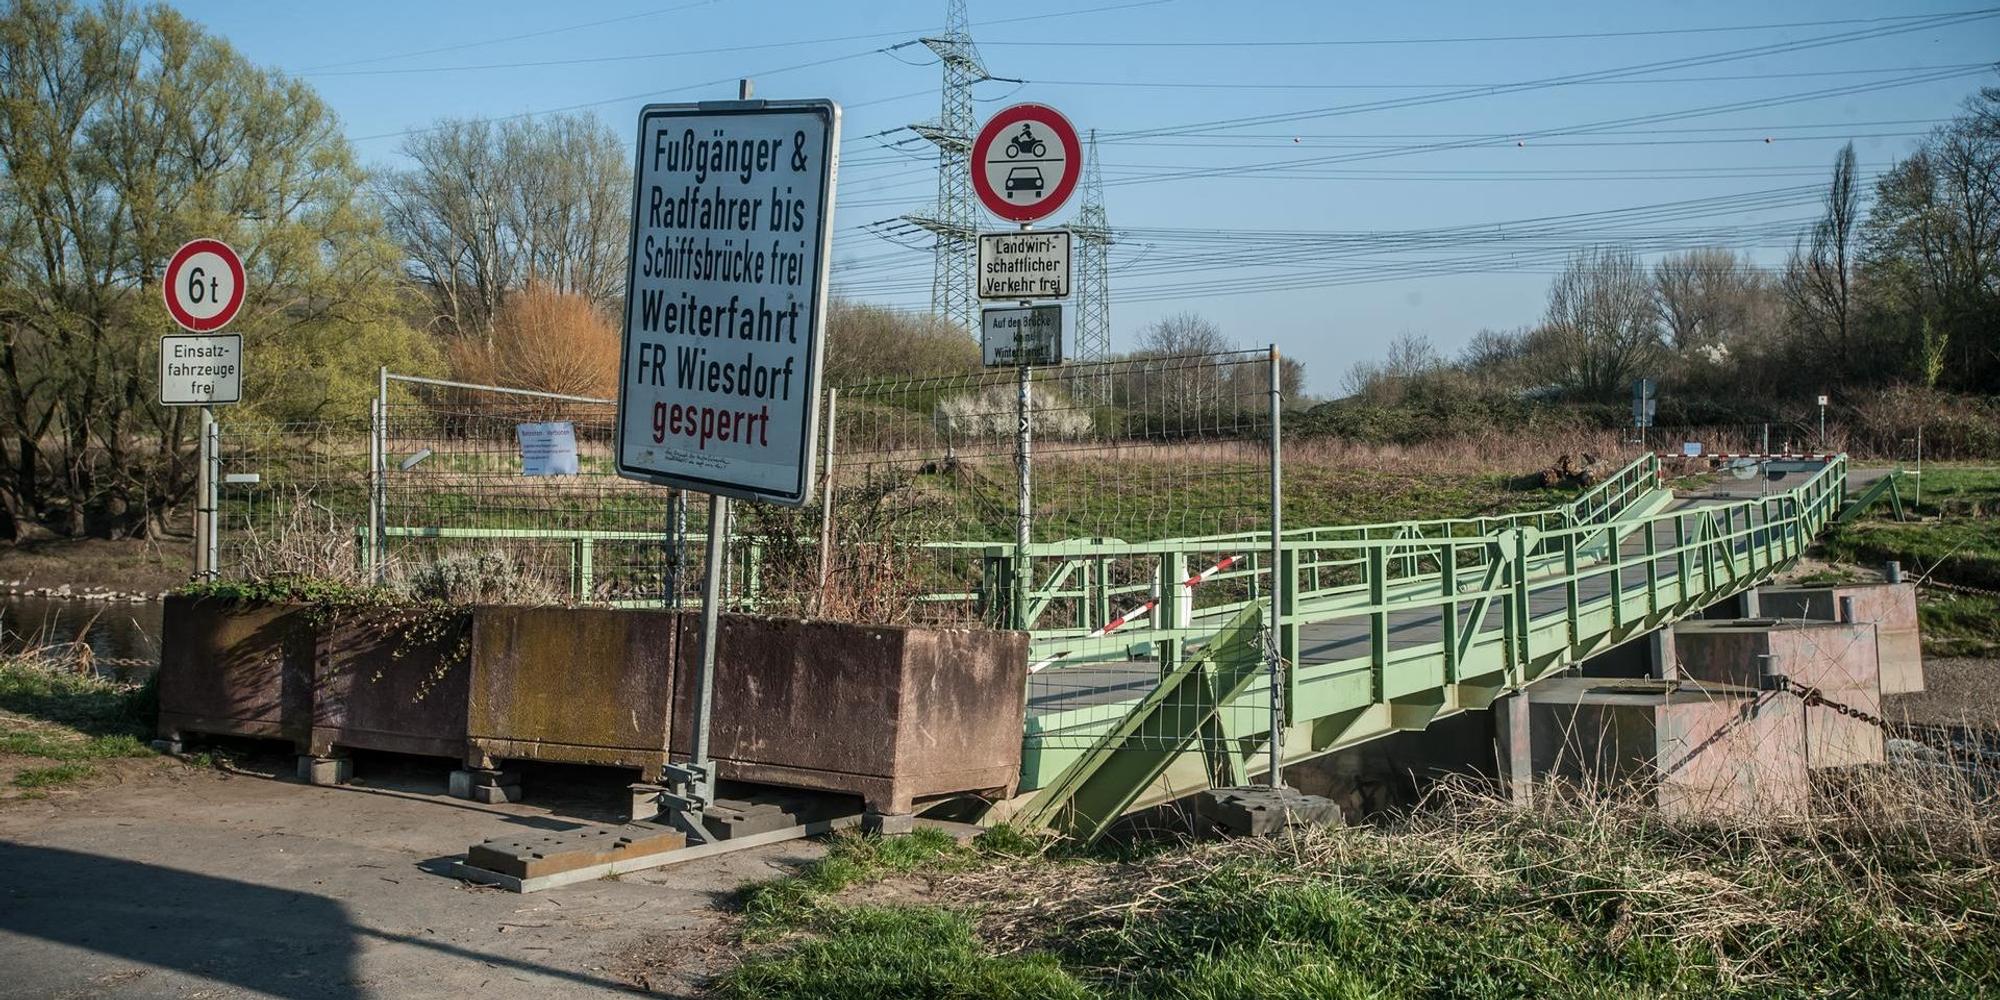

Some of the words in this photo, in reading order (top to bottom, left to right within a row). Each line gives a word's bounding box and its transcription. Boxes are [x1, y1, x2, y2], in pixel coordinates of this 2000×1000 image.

[653, 128, 782, 184] Fußgänger
[791, 130, 808, 172] &
[649, 185, 762, 232] Radfahrer
[769, 186, 805, 232] bis
[643, 235, 764, 284] Schiffsbrücke
[770, 240, 804, 286] frei
[987, 257, 1060, 273] schaftlicher
[986, 277, 1036, 292] Verkehr
[1040, 275, 1061, 291] frei
[642, 289, 798, 344] Weiterfahrt
[993, 318, 1006, 329] Auf
[174, 345, 229, 358] Einsatz-
[168, 363, 235, 378] fahrzeuge
[638, 342, 666, 387] FR
[677, 345, 794, 401] Wiesdorf
[191, 381, 214, 394] frei
[652, 401, 769, 450] gesperrt
